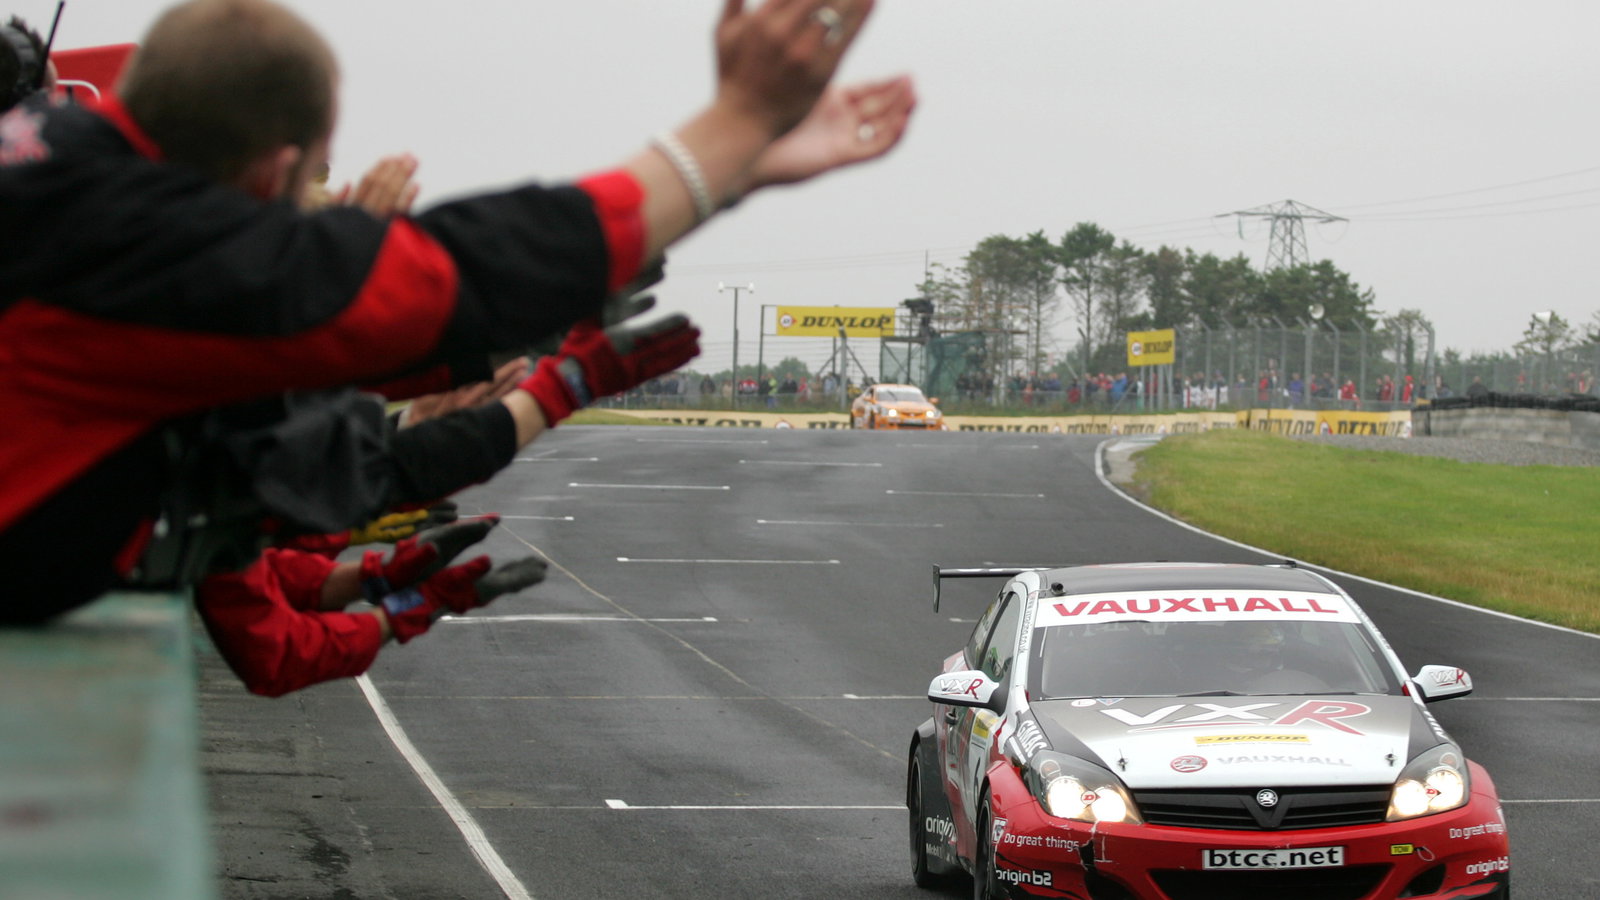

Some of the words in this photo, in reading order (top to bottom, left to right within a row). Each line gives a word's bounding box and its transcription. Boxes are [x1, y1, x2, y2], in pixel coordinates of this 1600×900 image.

[801, 315, 892, 328] DUNLOP
[1053, 597, 1338, 617] VAUXHALL
[1429, 668, 1467, 686] VXR
[940, 678, 984, 700] VXR
[1101, 700, 1371, 736] VXR
[1017, 720, 1047, 758] GMAC
[1217, 755, 1352, 767] VAUXHALL
[925, 815, 955, 841] origin
[1449, 828, 1462, 839] Do
[1463, 824, 1485, 839] great
[1004, 833, 1016, 844] Do
[1017, 835, 1043, 847] great
[1045, 836, 1079, 852] things
[1209, 848, 1340, 867] btcc.net
[995, 868, 1031, 885] origin
[1032, 870, 1052, 886] b2
[1466, 860, 1497, 876] origin
